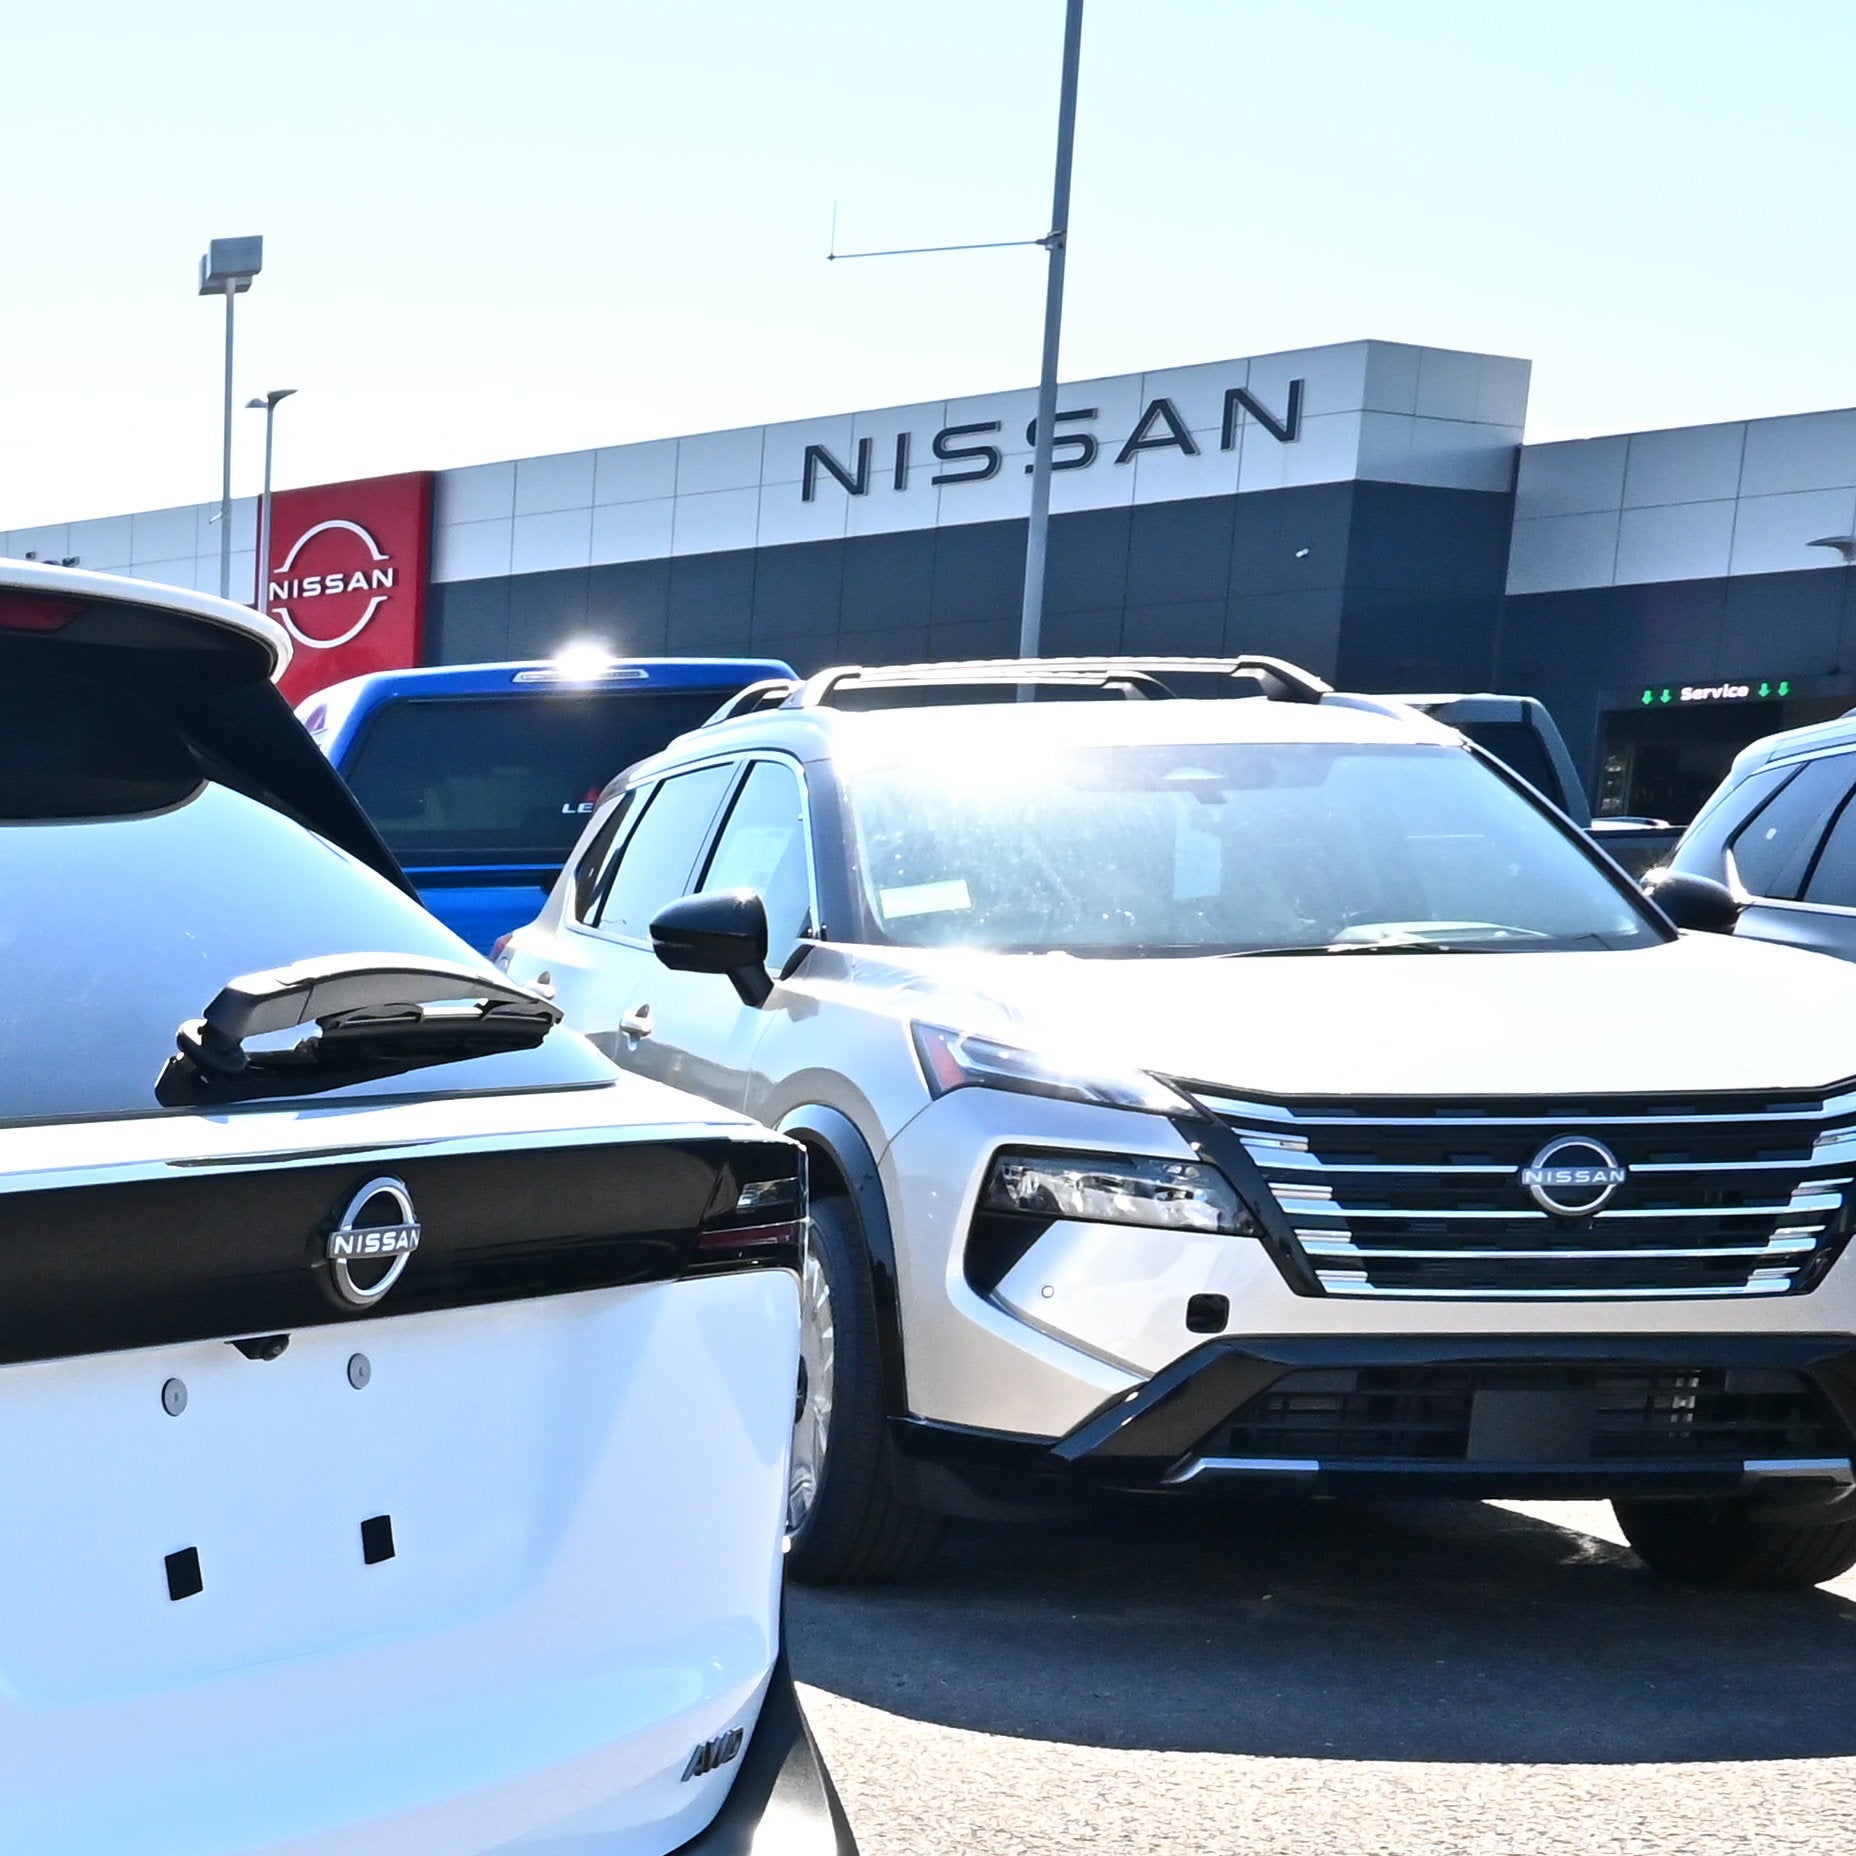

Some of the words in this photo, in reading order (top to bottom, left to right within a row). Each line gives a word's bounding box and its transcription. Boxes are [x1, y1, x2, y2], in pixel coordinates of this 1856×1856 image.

[801, 378, 1305, 502] NISSAN
[269, 567, 394, 601] NISSAN
[1680, 683, 1750, 701] Service
[1525, 1169, 1626, 1183] NISSAN
[334, 1229, 420, 1254] NISSAN
